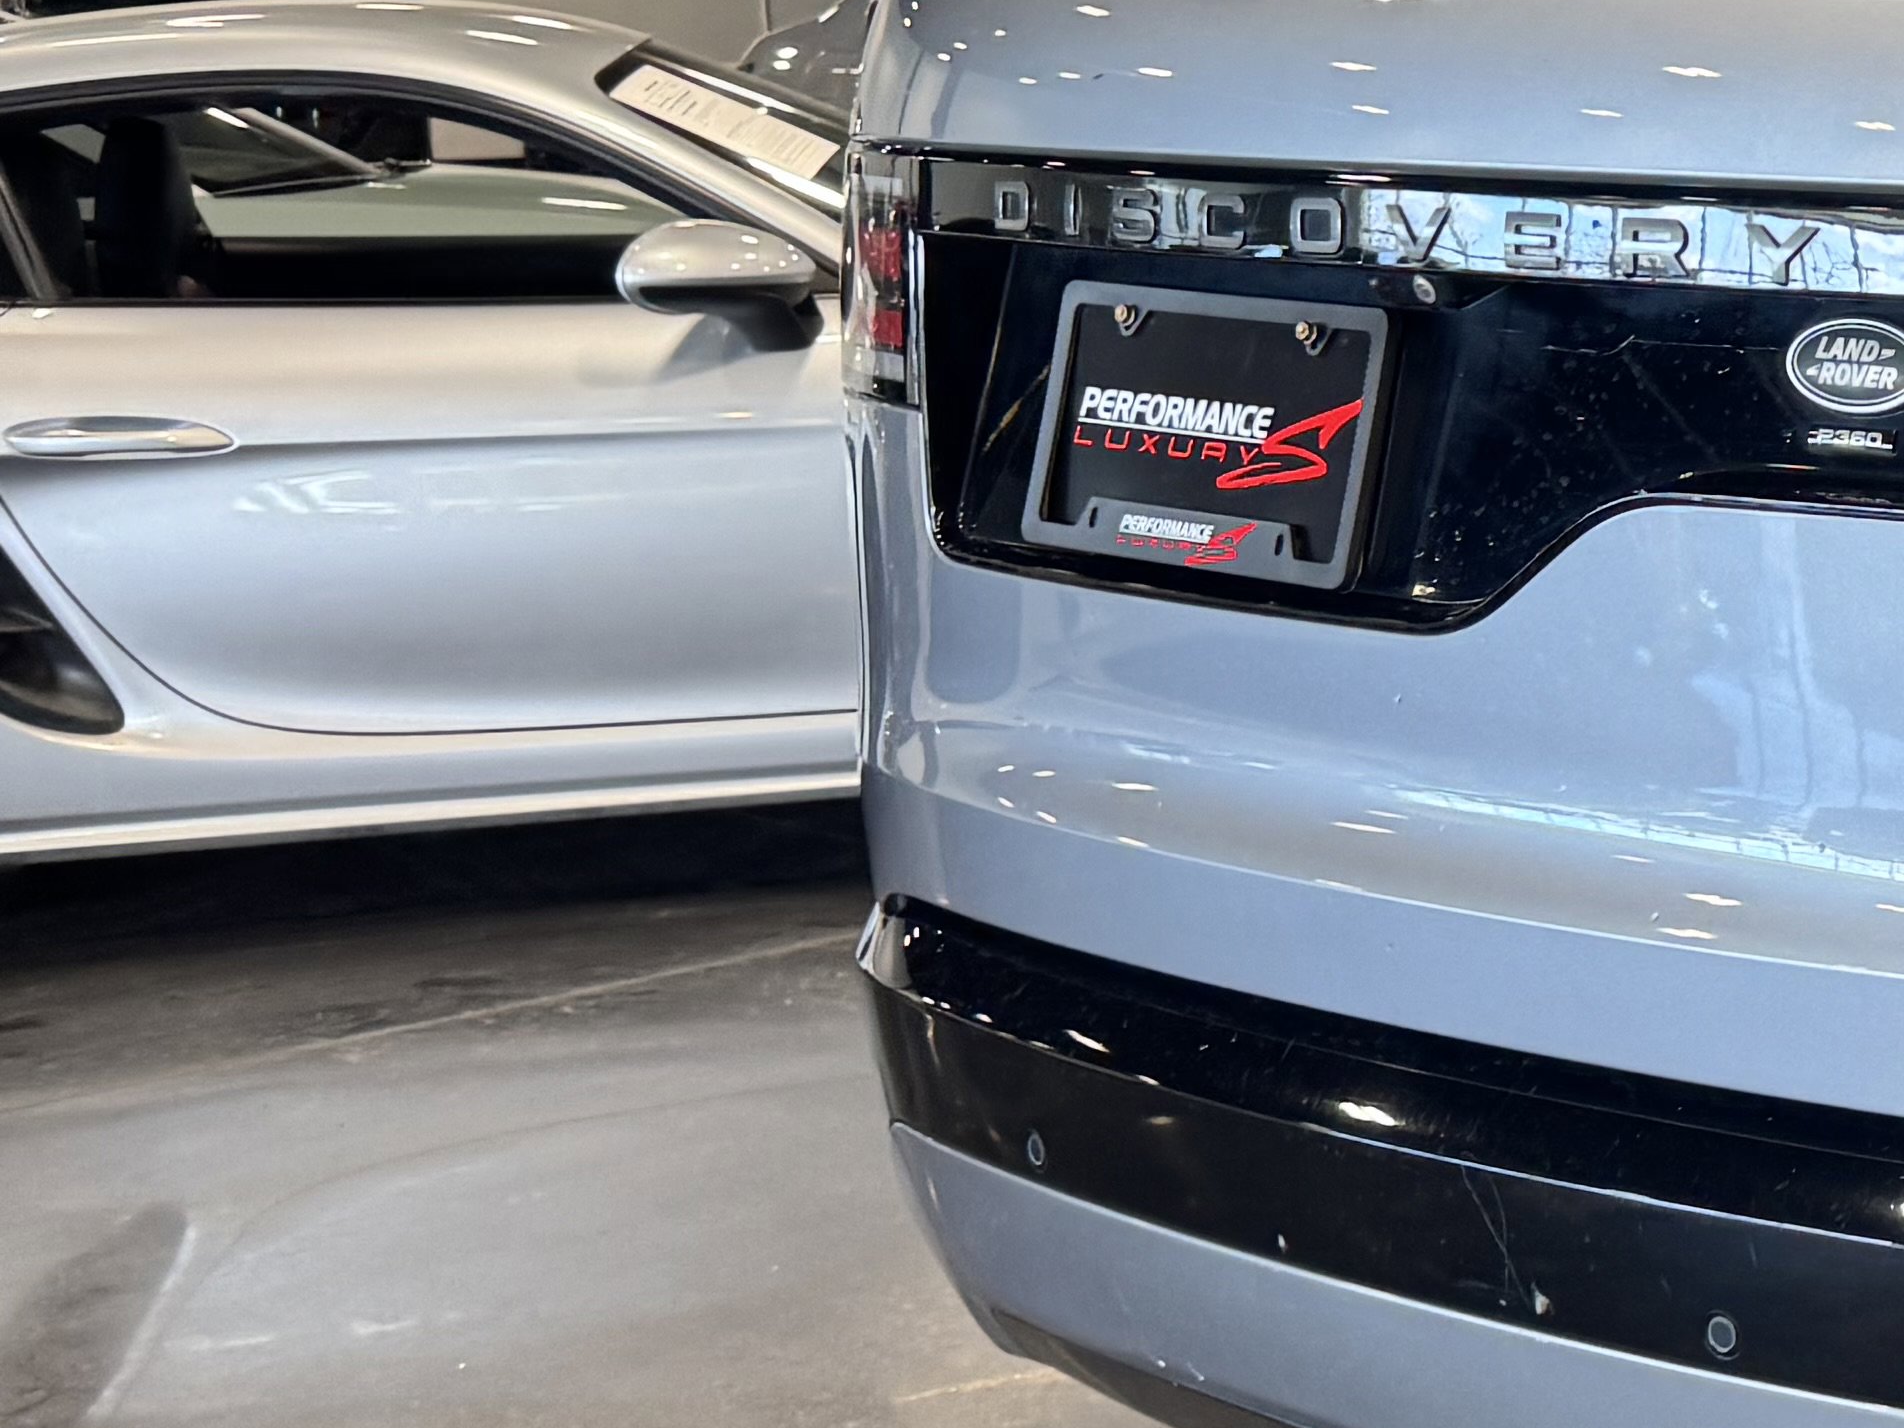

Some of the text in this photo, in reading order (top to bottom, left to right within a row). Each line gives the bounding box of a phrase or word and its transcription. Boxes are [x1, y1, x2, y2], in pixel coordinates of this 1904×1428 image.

[994, 180, 1821, 286] DISCOVERY
[1815, 336, 1880, 363] LAND
[1817, 361, 1898, 390] ROVER
[1079, 386, 1275, 439] PERFORMANCE
[1073, 424, 1260, 465] LUXURY
[1119, 514, 1214, 542] PERFORMANCE
